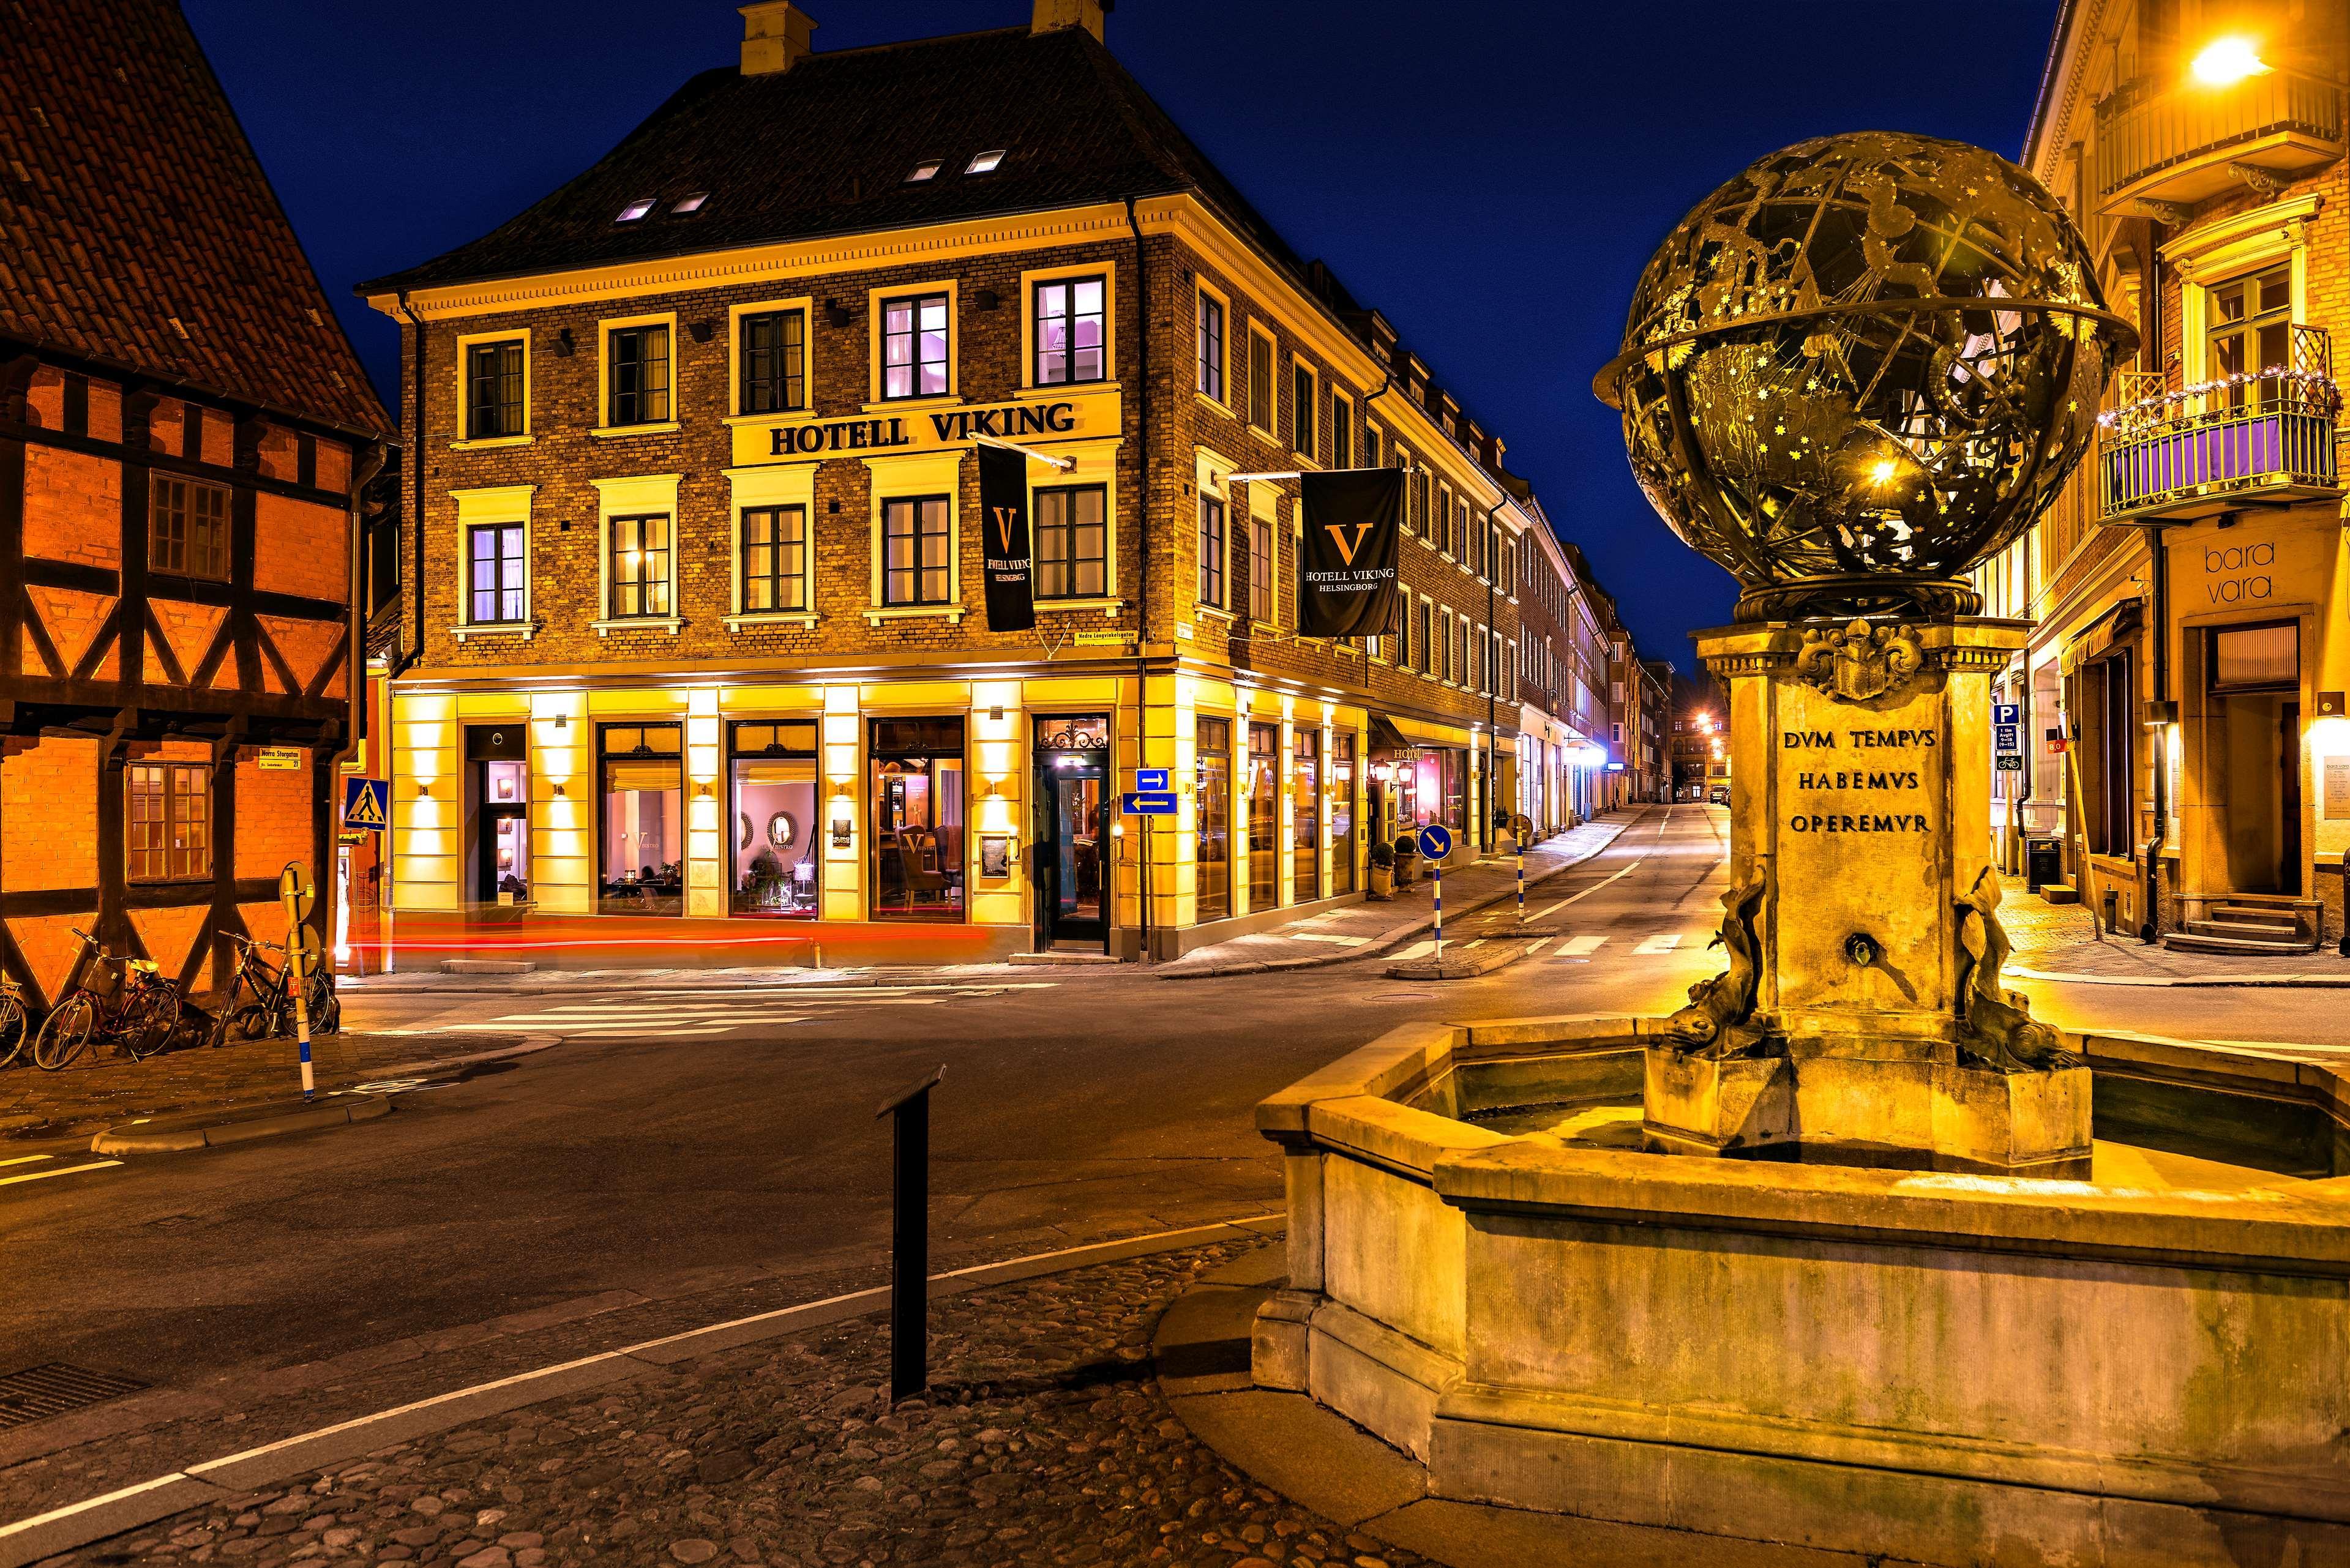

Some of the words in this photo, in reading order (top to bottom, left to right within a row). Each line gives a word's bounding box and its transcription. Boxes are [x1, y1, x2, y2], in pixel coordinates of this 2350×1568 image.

[769, 417, 910, 455] HOTELL
[929, 402, 1075, 442] VIKING
[993, 507, 1016, 554] V
[1325, 523, 1374, 566] V
[2205, 542, 2275, 573] bara
[1306, 572, 1349, 581] HOTELL
[1353, 568, 1395, 580] VIKING
[1319, 583, 1378, 592] HELSINGBORG
[2207, 576, 2272, 604] vara
[2000, 706, 2013, 723] P
[1784, 731, 1836, 749] DVM
[1849, 730, 1936, 747] TEMPVS
[277, 750, 298, 759] Storgatan
[1798, 772, 1918, 789] HABEMVS
[1791, 815, 1931, 832] OPEREMVR
[903, 834, 924, 854] V
